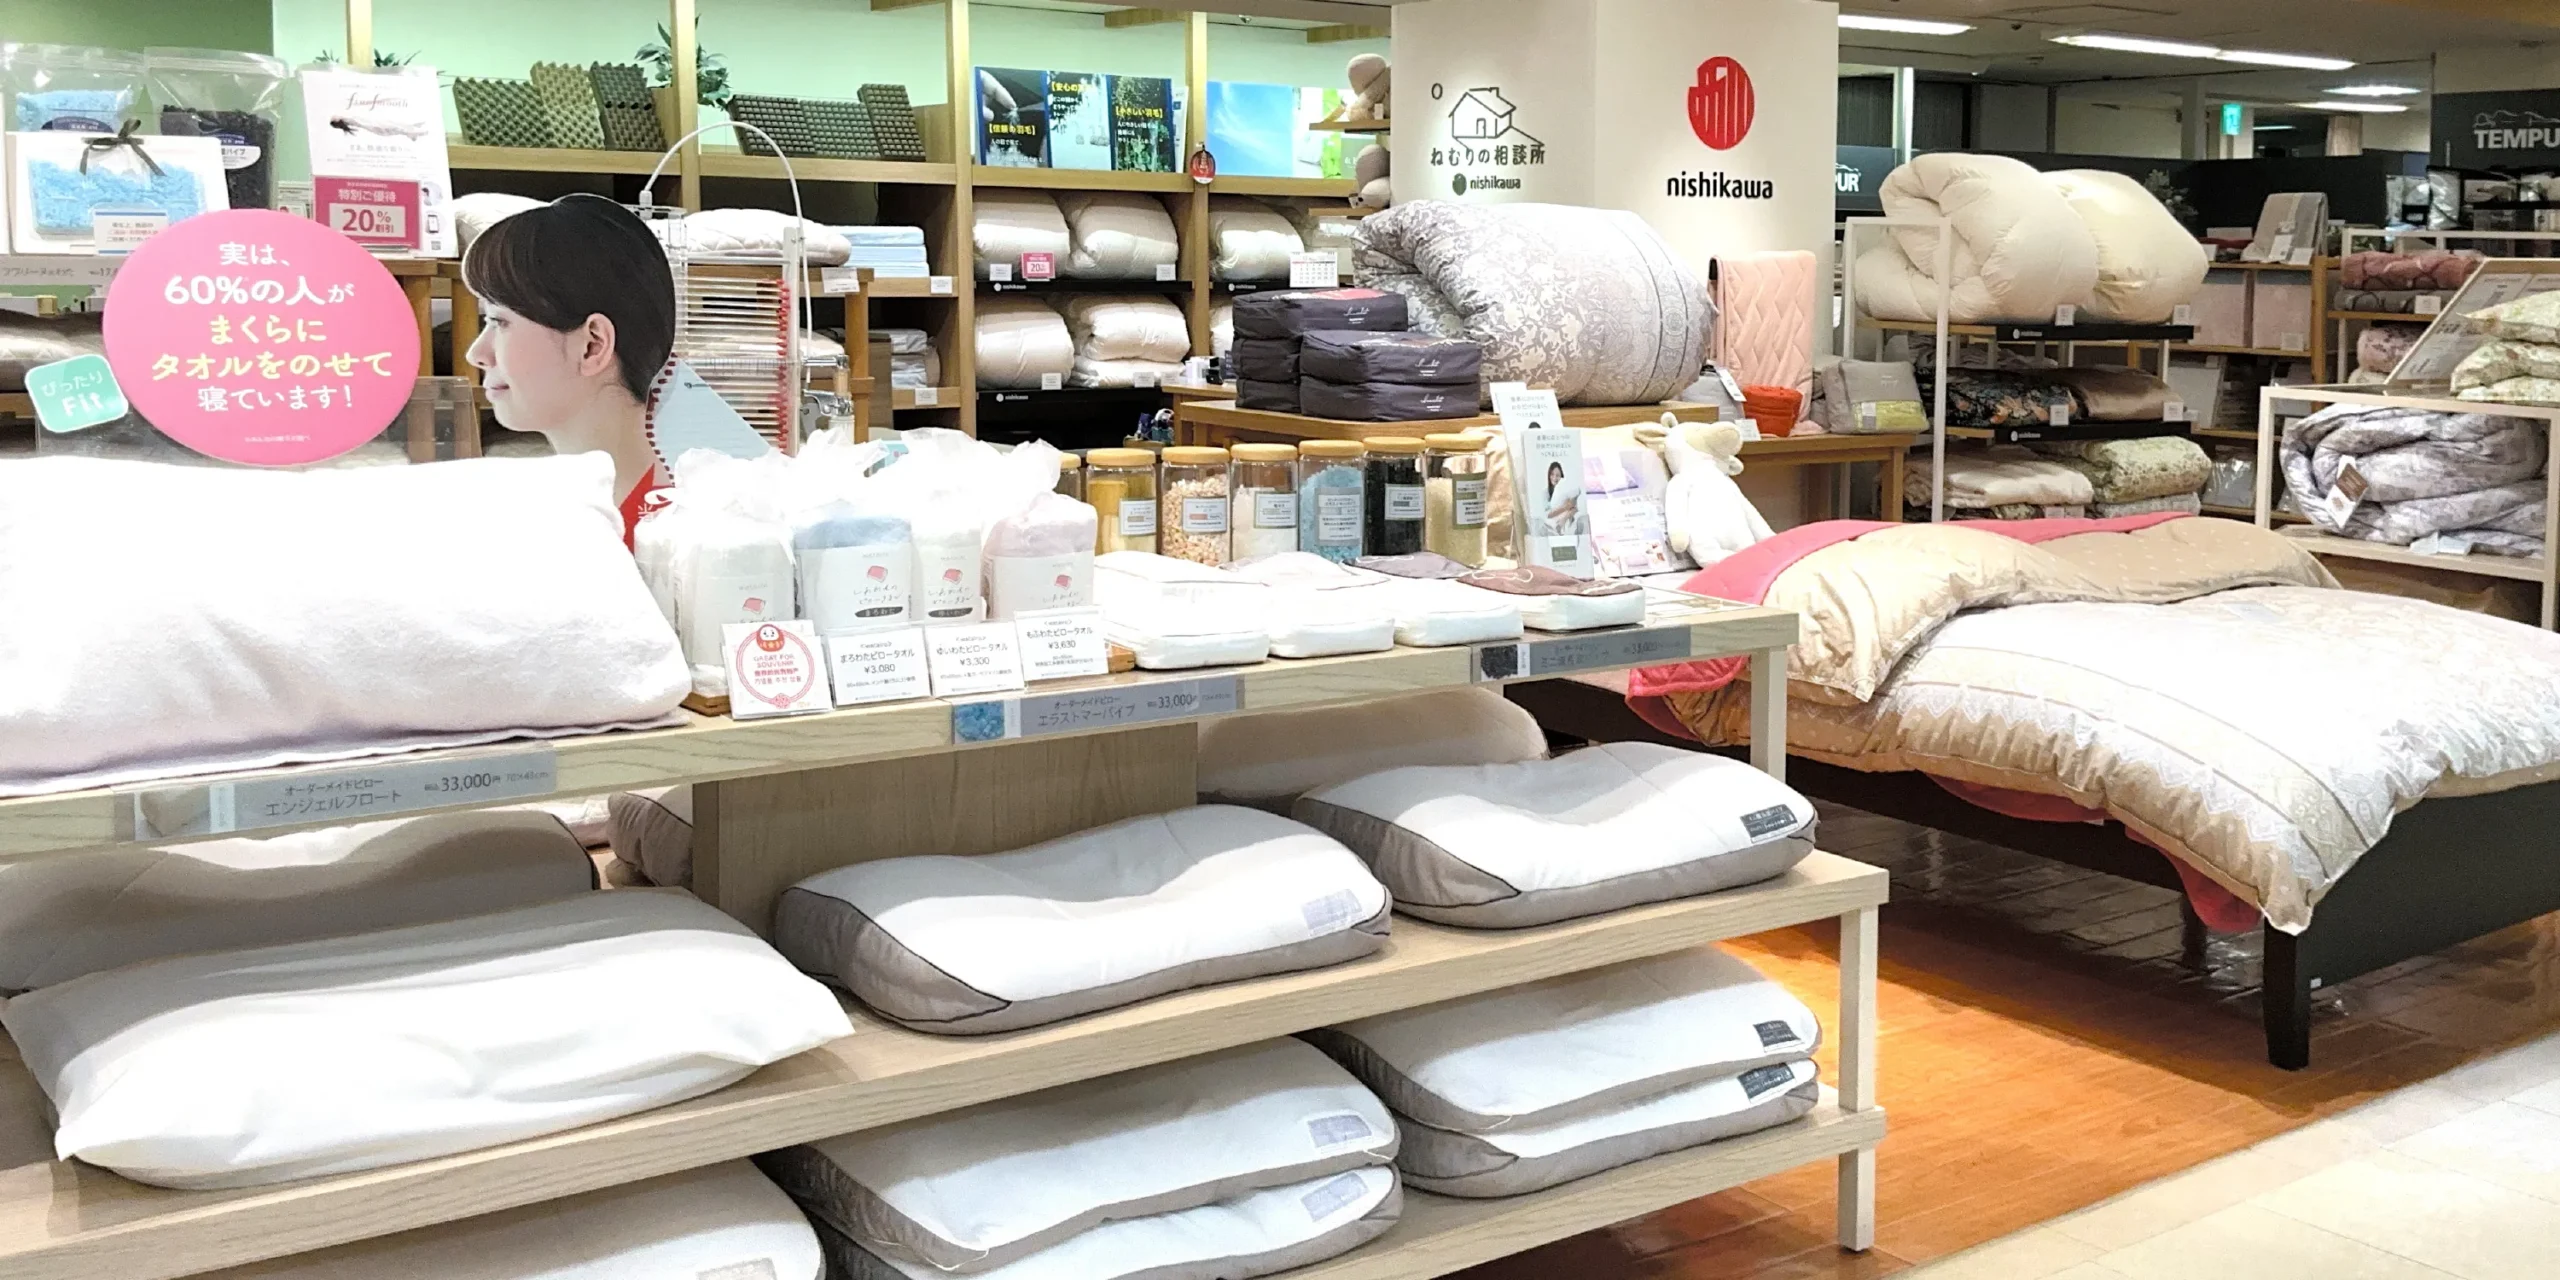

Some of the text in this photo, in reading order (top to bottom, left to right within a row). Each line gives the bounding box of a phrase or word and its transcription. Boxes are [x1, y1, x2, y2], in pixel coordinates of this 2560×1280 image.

[1430, 144, 1545, 166] ねむりの相談所
[1470, 175, 1521, 189] nishikawa
[1666, 170, 1773, 199] nishikawa
[1835, 172, 1860, 192] UR
[338, 188, 396, 203] 特別ご優待
[219, 242, 290, 266] 実は、
[164, 275, 355, 305] 60%の人が
[209, 315, 327, 344] まくらに
[152, 351, 392, 381] タオルをのせて
[62, 392, 104, 417] Fit
[197, 385, 352, 411] 寝ています!
[1047, 640, 1077, 650] ¥3,630
[863, 663, 896, 674] ¥3,080
[1038, 705, 1135, 727] エラストマーパイプ
[265, 789, 402, 816] エンジェルフロート
